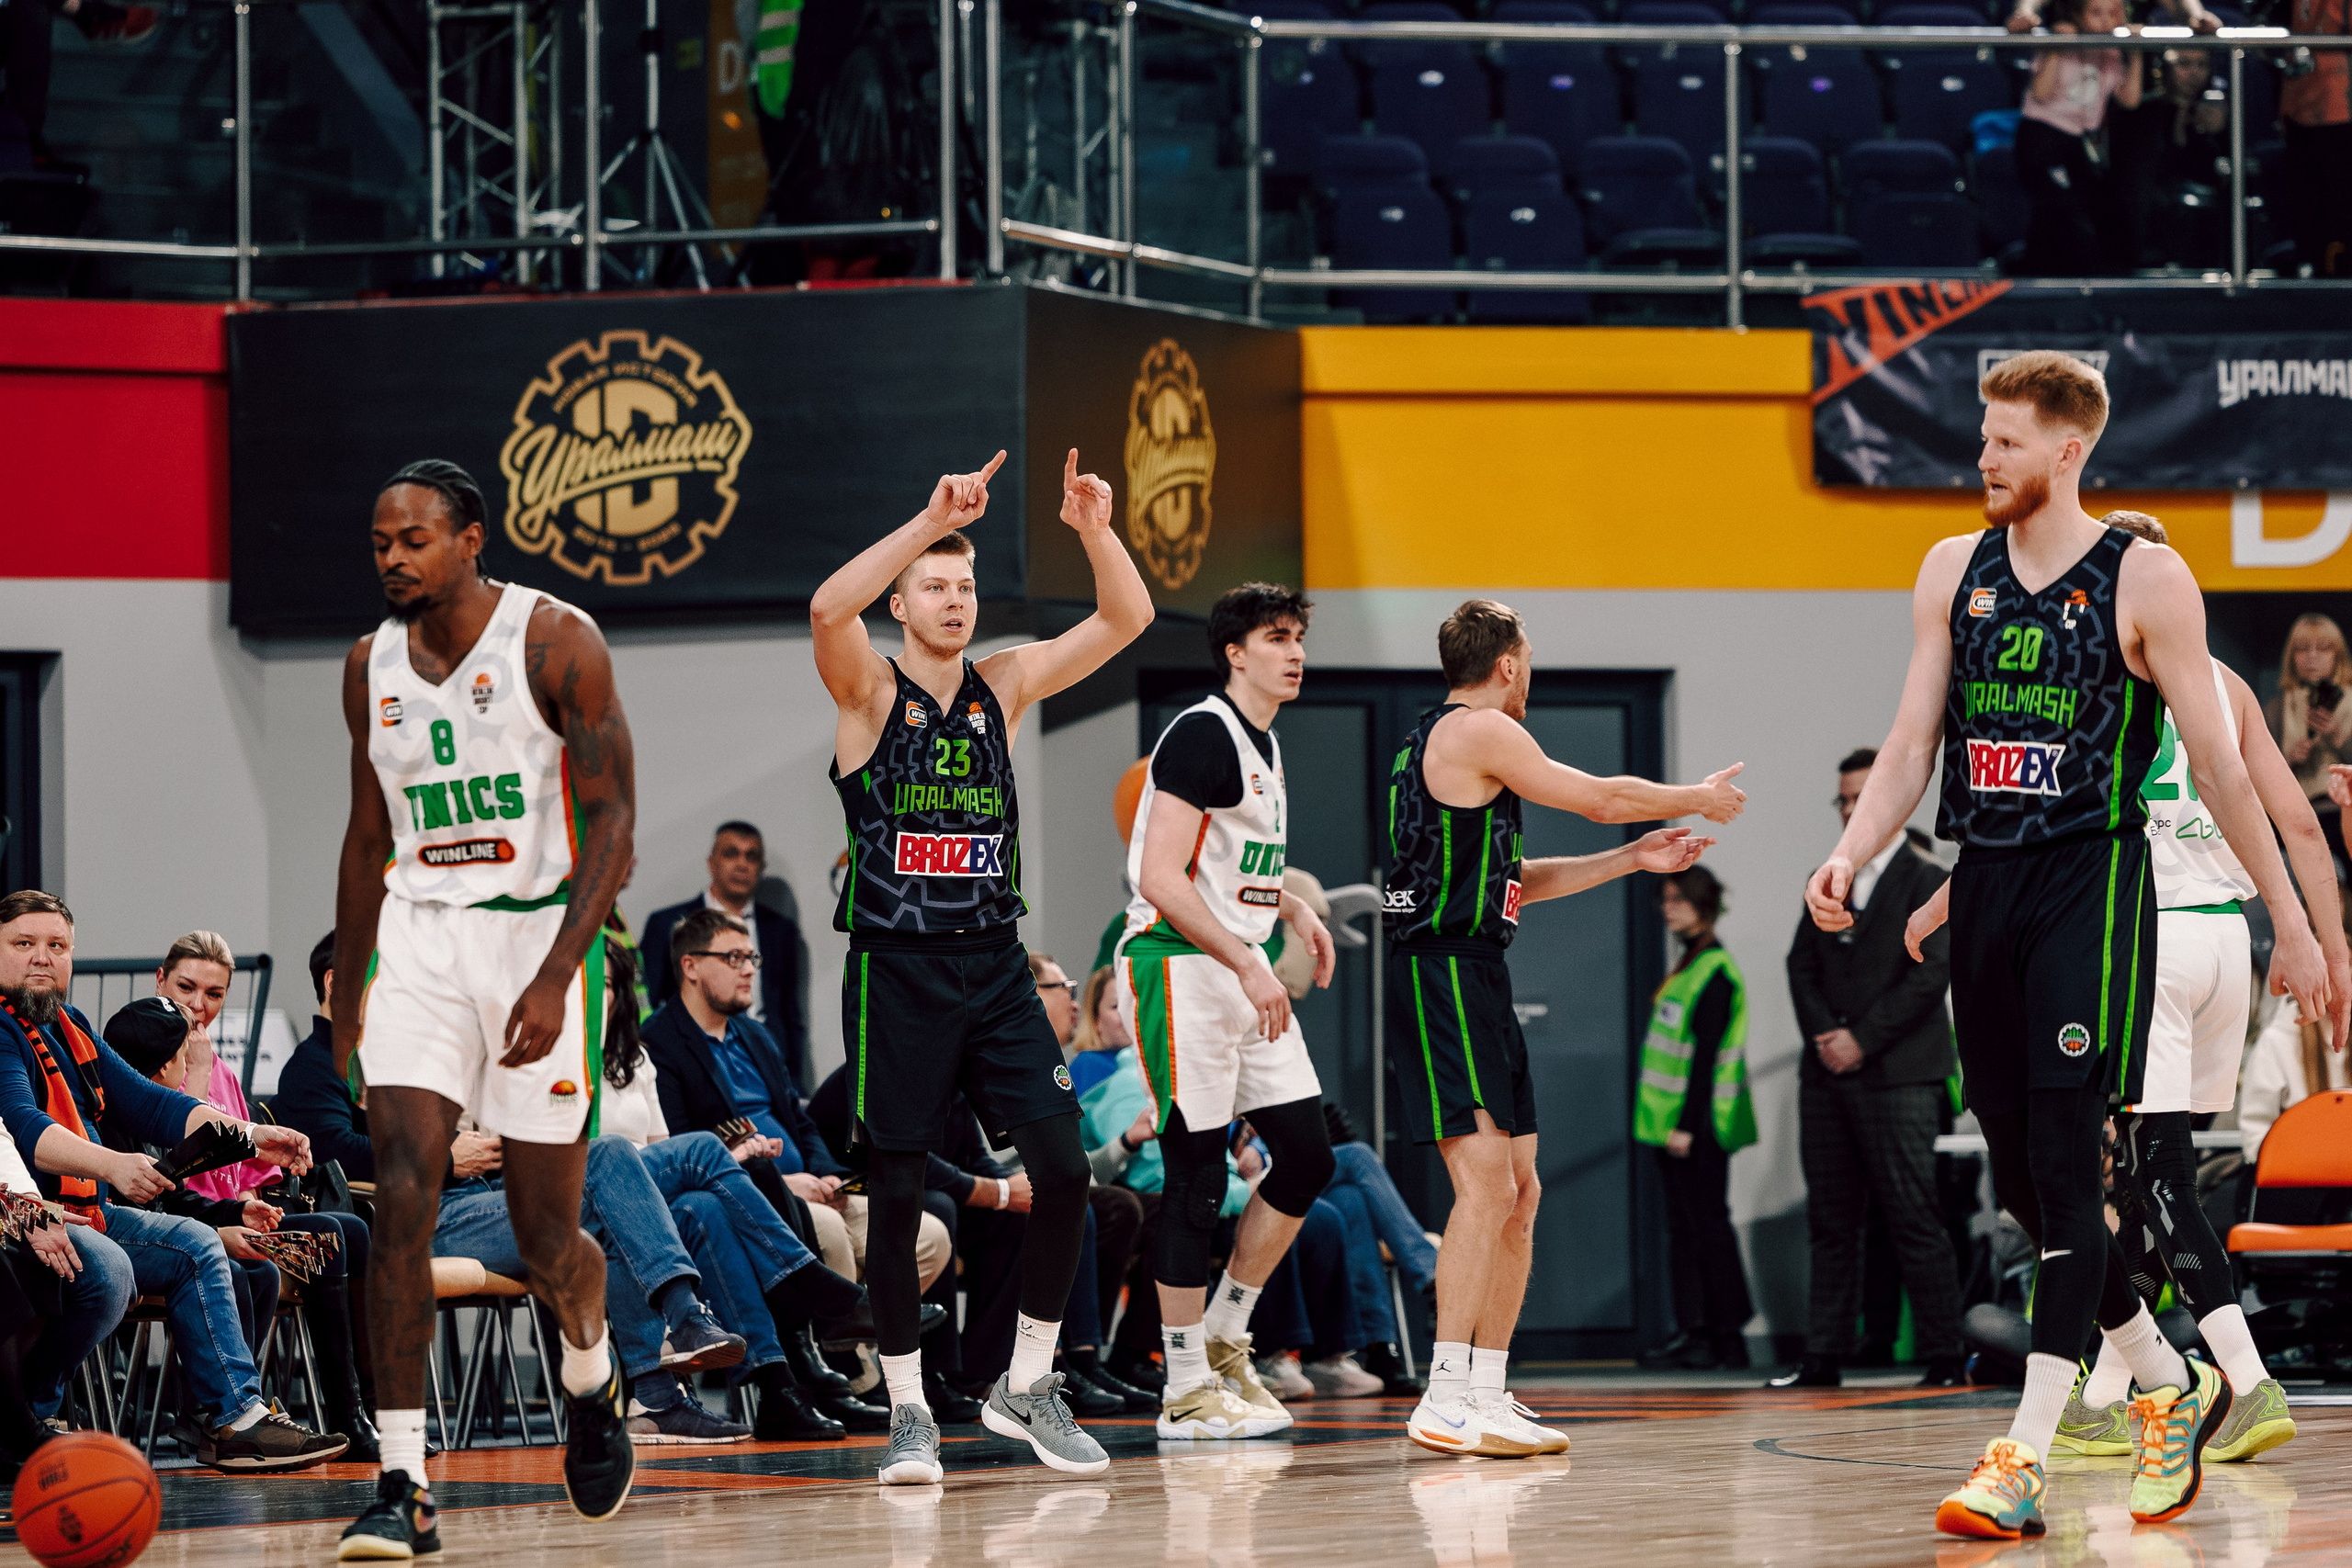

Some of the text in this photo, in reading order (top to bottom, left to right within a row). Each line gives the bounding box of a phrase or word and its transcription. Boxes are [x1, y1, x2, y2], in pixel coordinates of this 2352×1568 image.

[2217, 359, 2352, 409] УРАЛМА
[1997, 626, 2044, 672] 20
[911, 709, 926, 720] WIN
[1964, 682, 2078, 729] URALMASH
[430, 719, 456, 766] 8
[935, 738, 971, 777] 23
[894, 783, 1004, 819] URALMASH
[425, 843, 496, 863] WINLINE
[898, 834, 1002, 875] BROZEX
[1242, 889, 1279, 904] WINLINE
